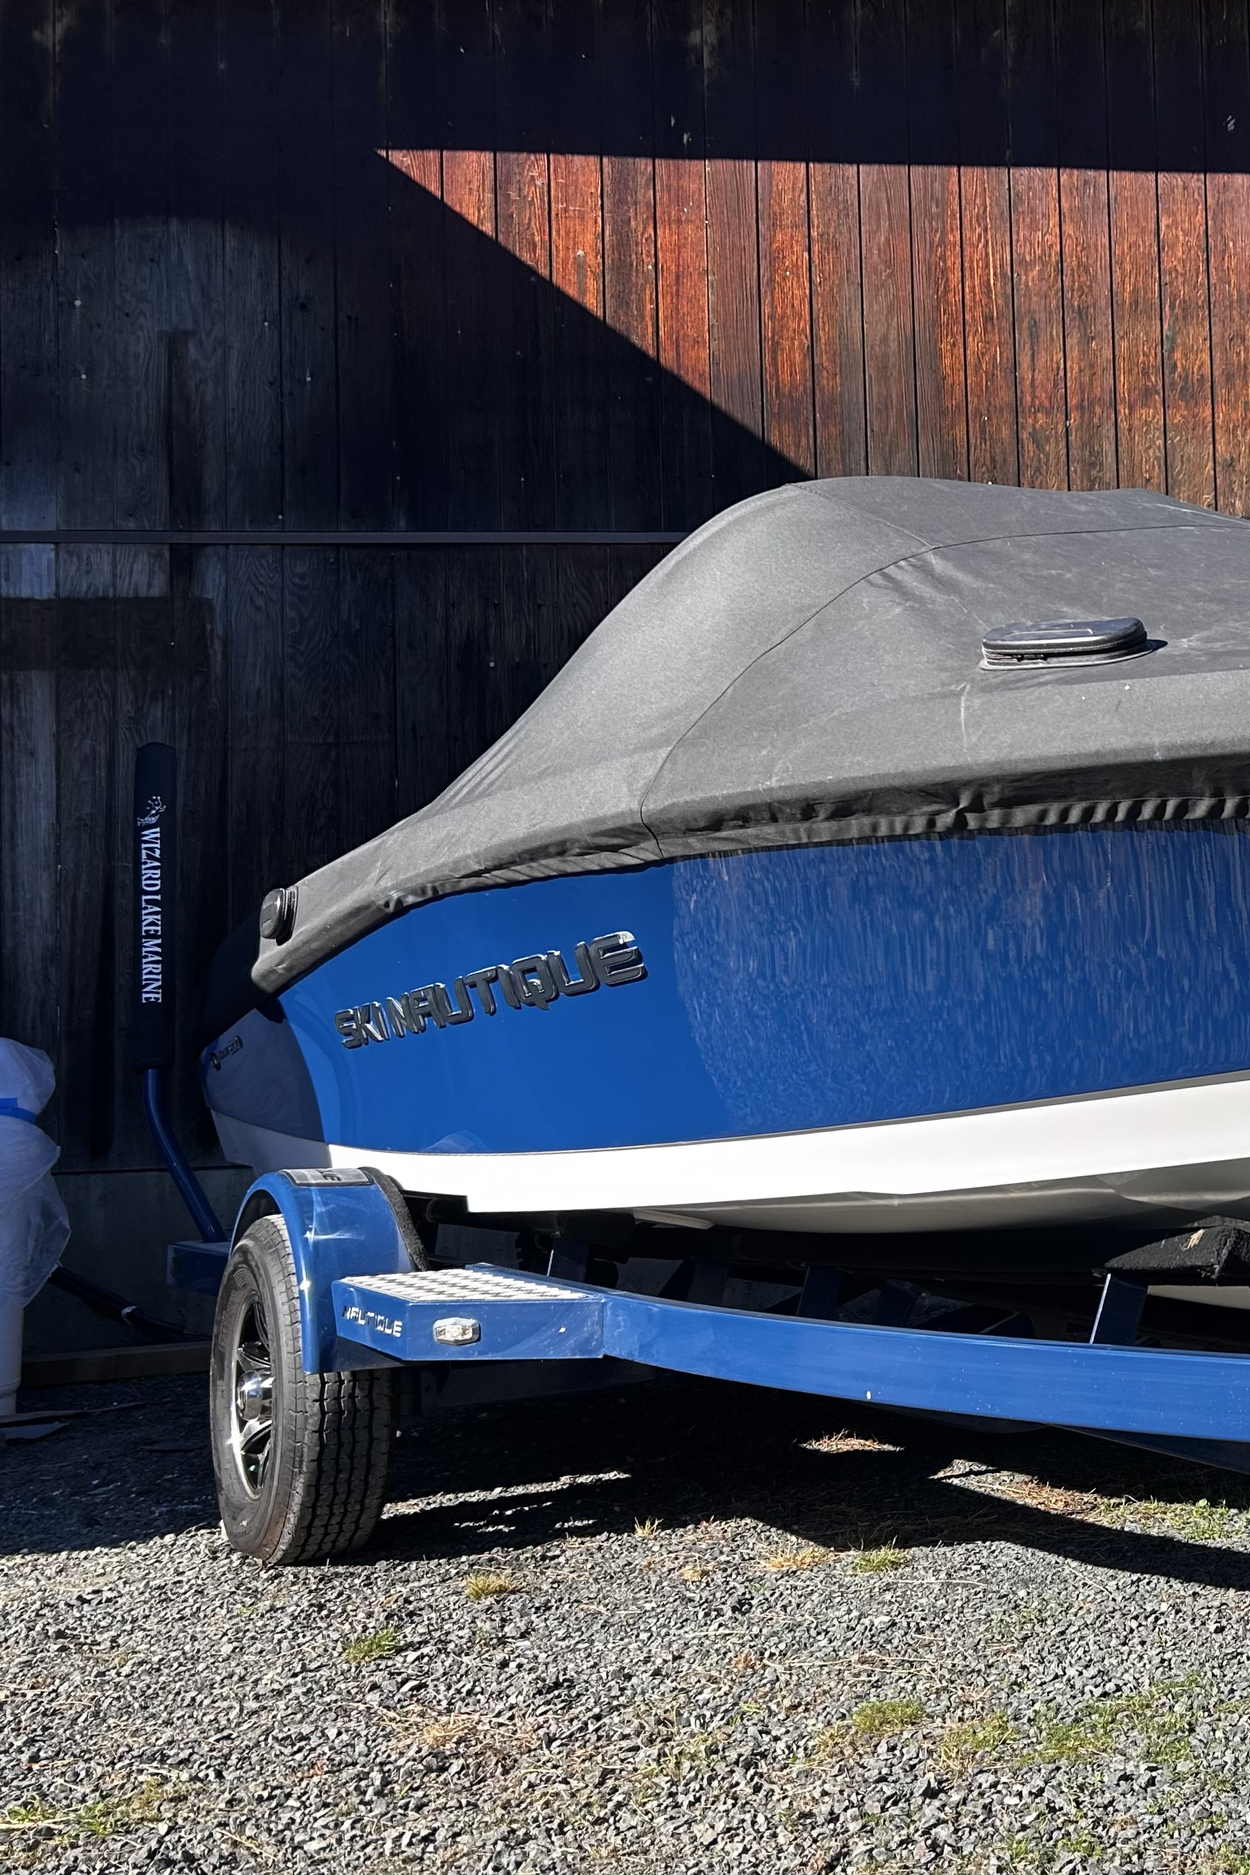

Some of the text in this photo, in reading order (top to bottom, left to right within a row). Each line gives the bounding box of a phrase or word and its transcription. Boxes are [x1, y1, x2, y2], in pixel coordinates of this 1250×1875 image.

[140, 826, 163, 1004] WIZARD LAKE MARINE
[341, 1305, 403, 1338] NAUTIQUE
